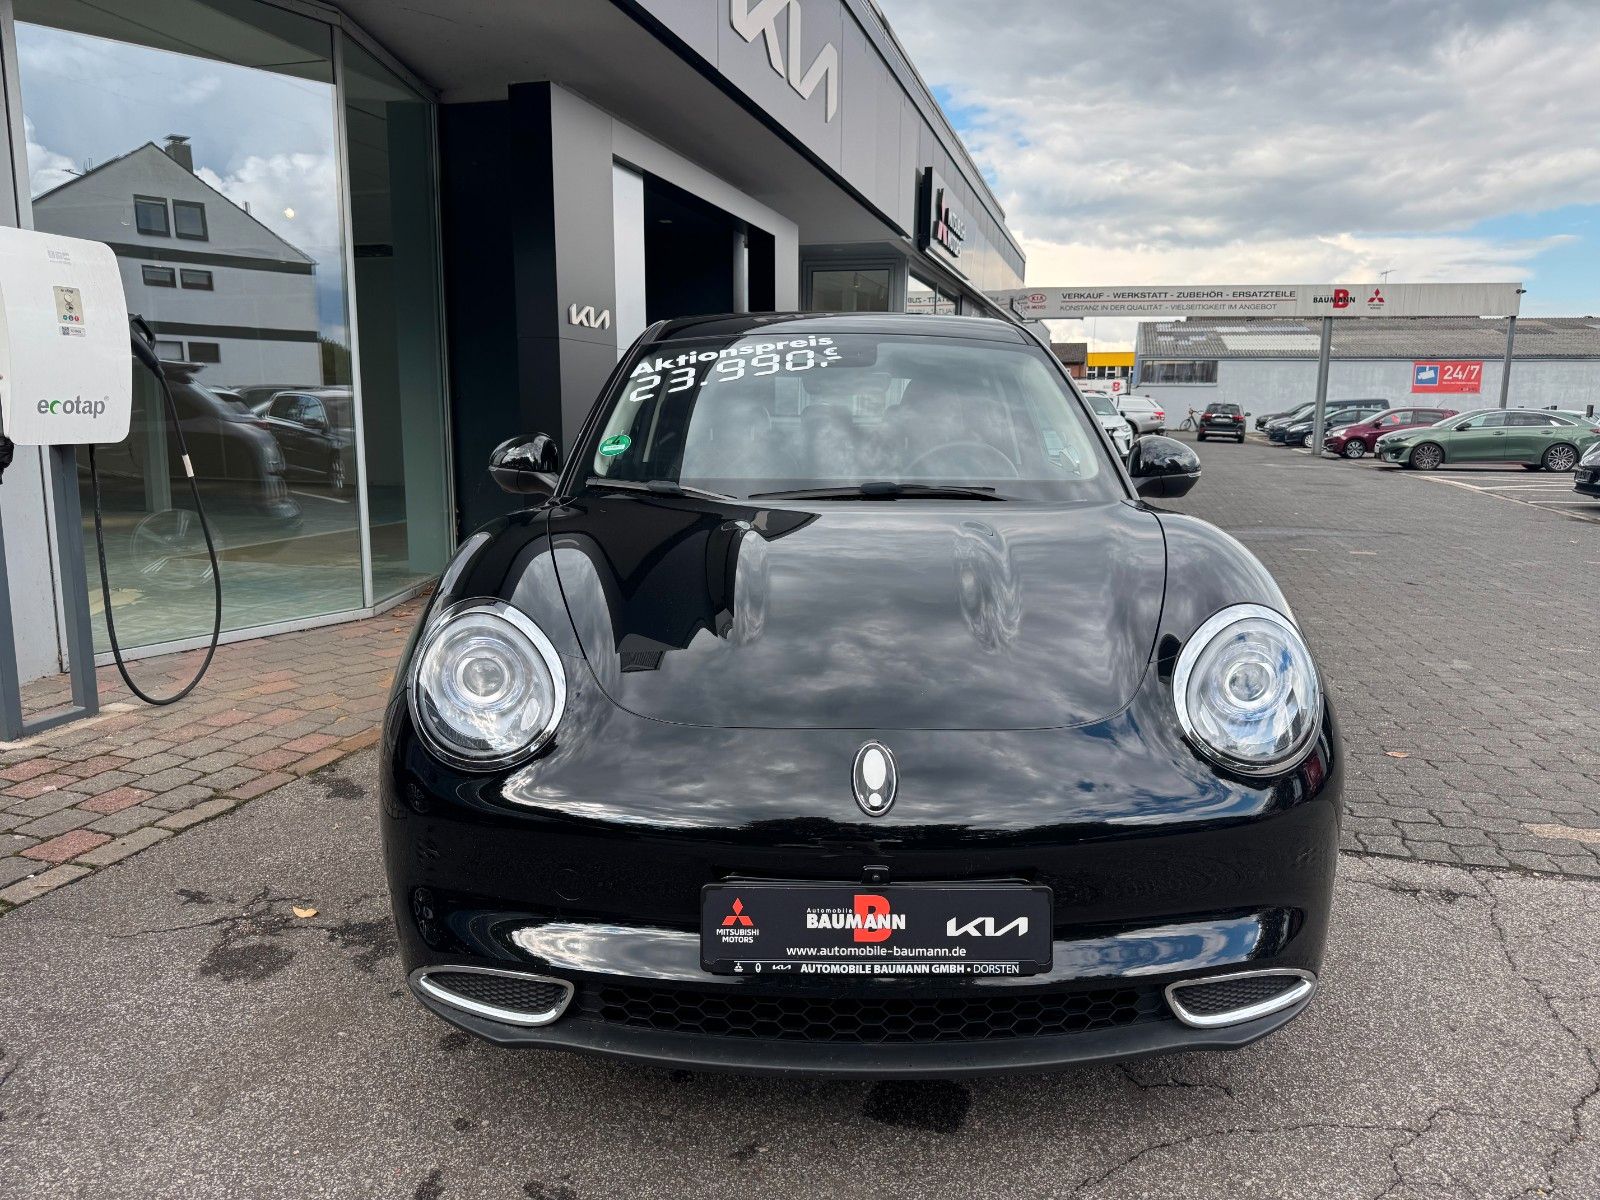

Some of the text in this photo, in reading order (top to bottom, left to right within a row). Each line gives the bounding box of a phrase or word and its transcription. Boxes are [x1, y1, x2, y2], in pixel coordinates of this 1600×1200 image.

[732, 0, 838, 123] KIA
[1177, 290, 1223, 298] ZUBEHÖR
[1232, 290, 1296, 298] ERSATZTEILE
[569, 303, 610, 329] KIA
[630, 335, 834, 379] Aktionspreis
[1443, 364, 1480, 380] 24/7
[806, 914, 906, 930] BAUMANN
[946, 916, 1029, 937] KIA
[716, 928, 760, 936] MITSUBISHI
[722, 936, 754, 944] MOTORS
[786, 945, 967, 957] www.automobile-baumann.de
[800, 964, 872, 975] AUTOMOBILE
[873, 964, 930, 975] BAUMANN
[931, 964, 965, 974] GMBH
[973, 964, 1020, 974] DORSTEN
